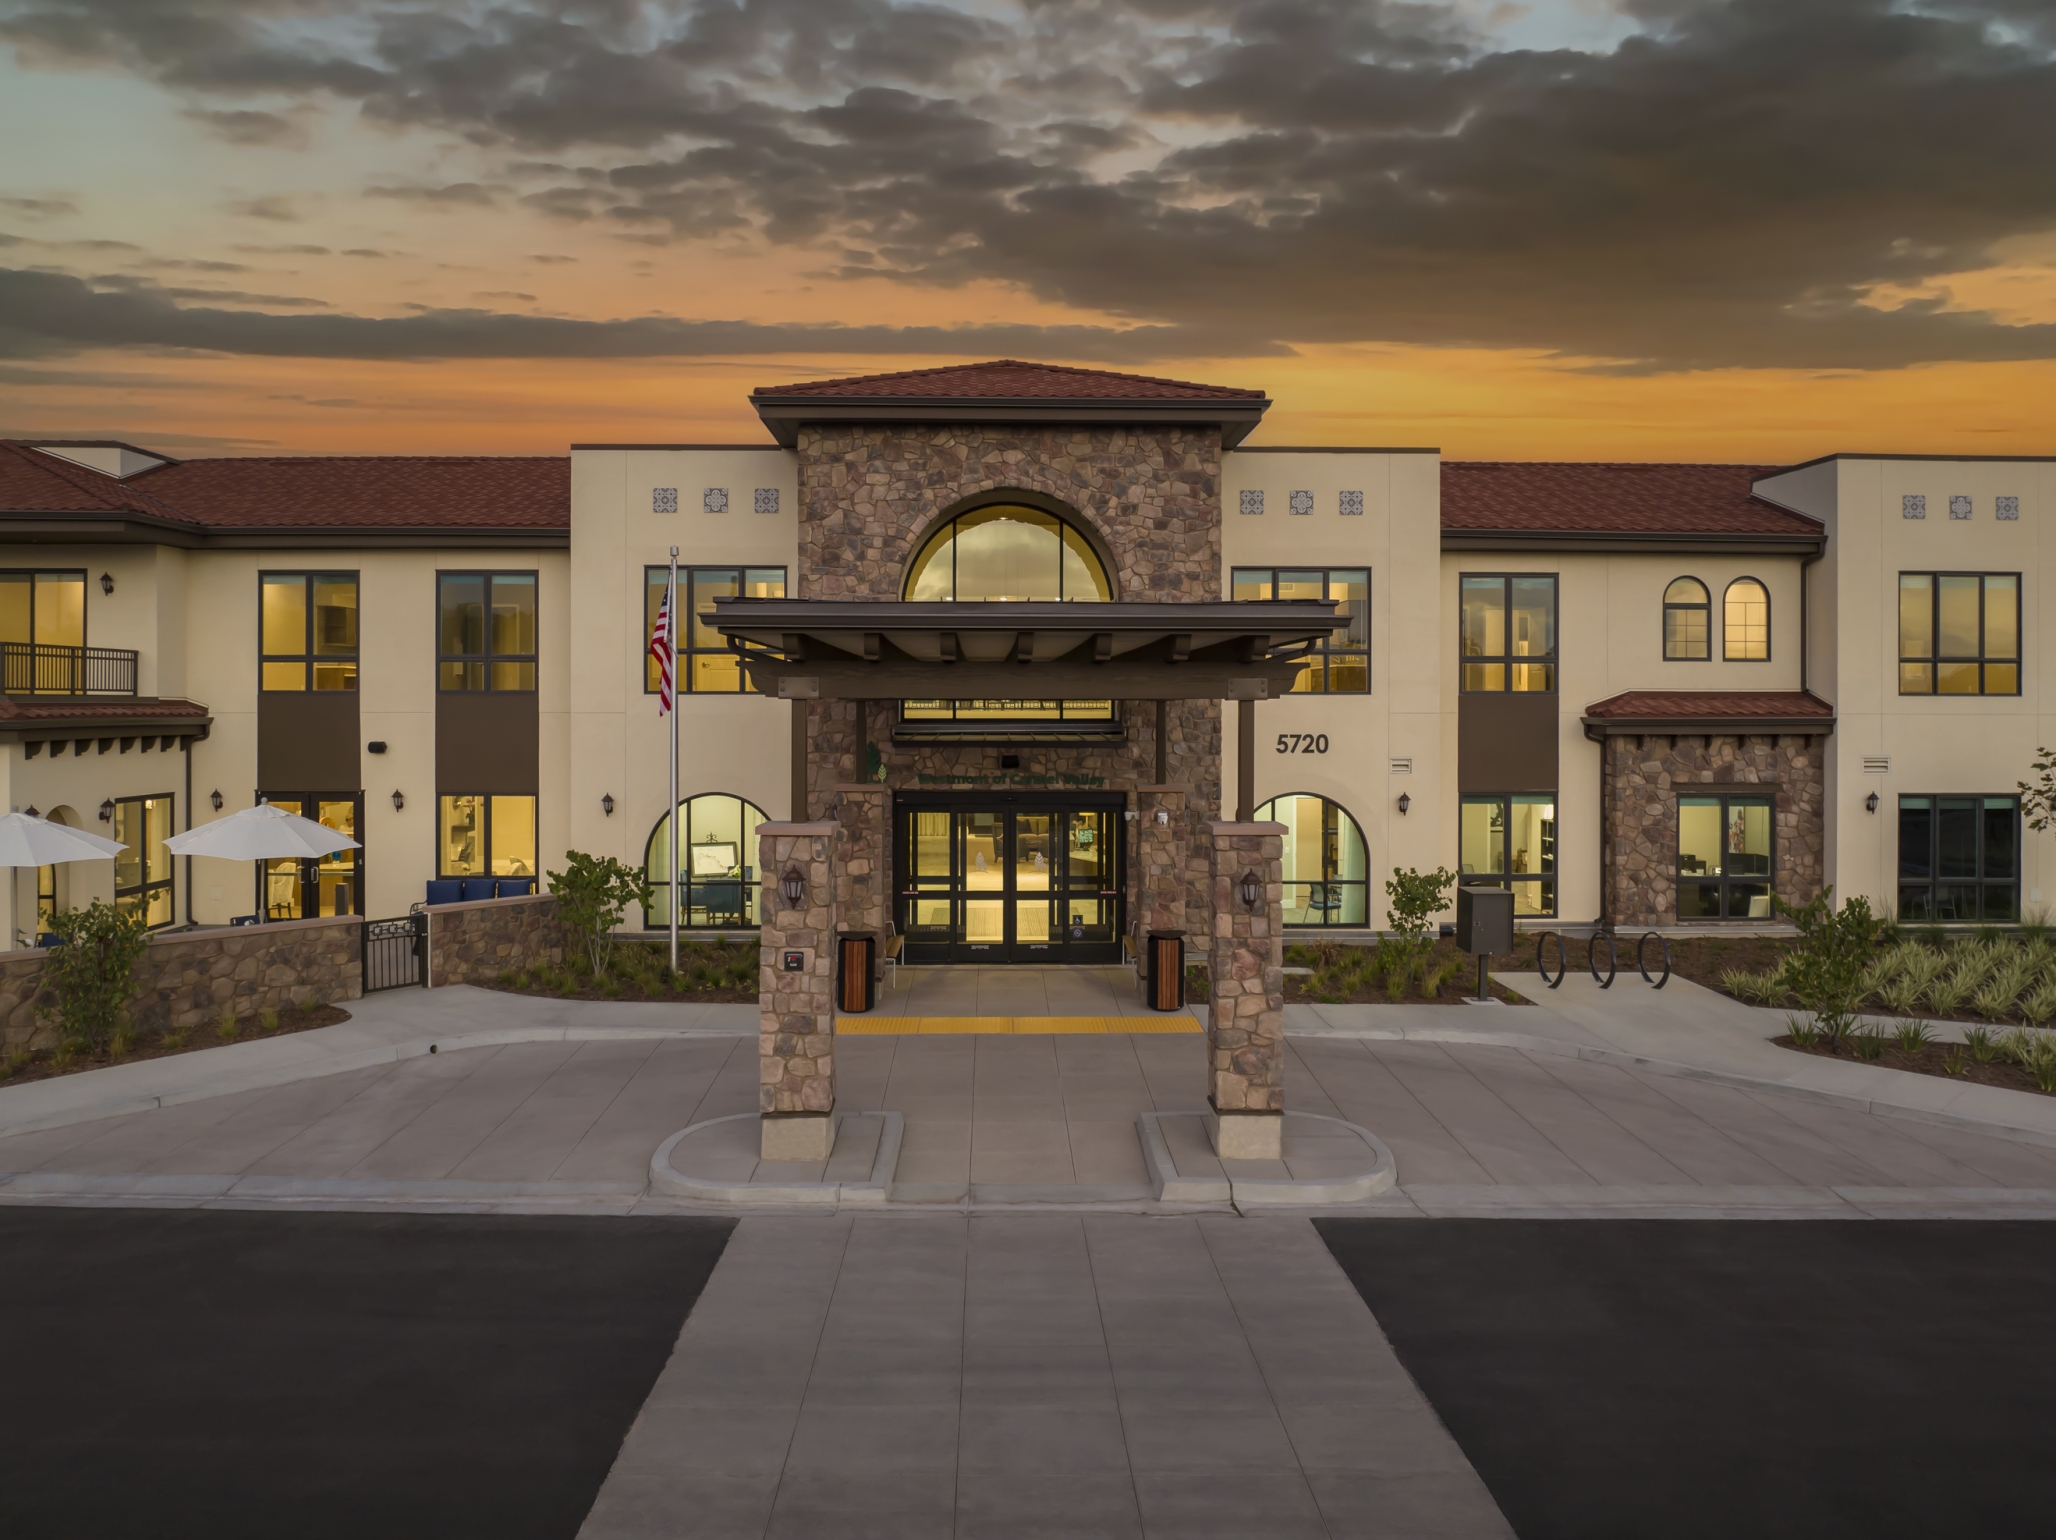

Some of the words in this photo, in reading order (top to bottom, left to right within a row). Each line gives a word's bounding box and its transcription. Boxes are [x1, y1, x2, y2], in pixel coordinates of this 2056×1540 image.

[1275, 733, 1329, 754] 5720
[917, 773, 989, 785] Westmont
[993, 773, 1008, 785] of
[1010, 773, 1060, 785] Carmel
[1063, 773, 1106, 788] Valley
